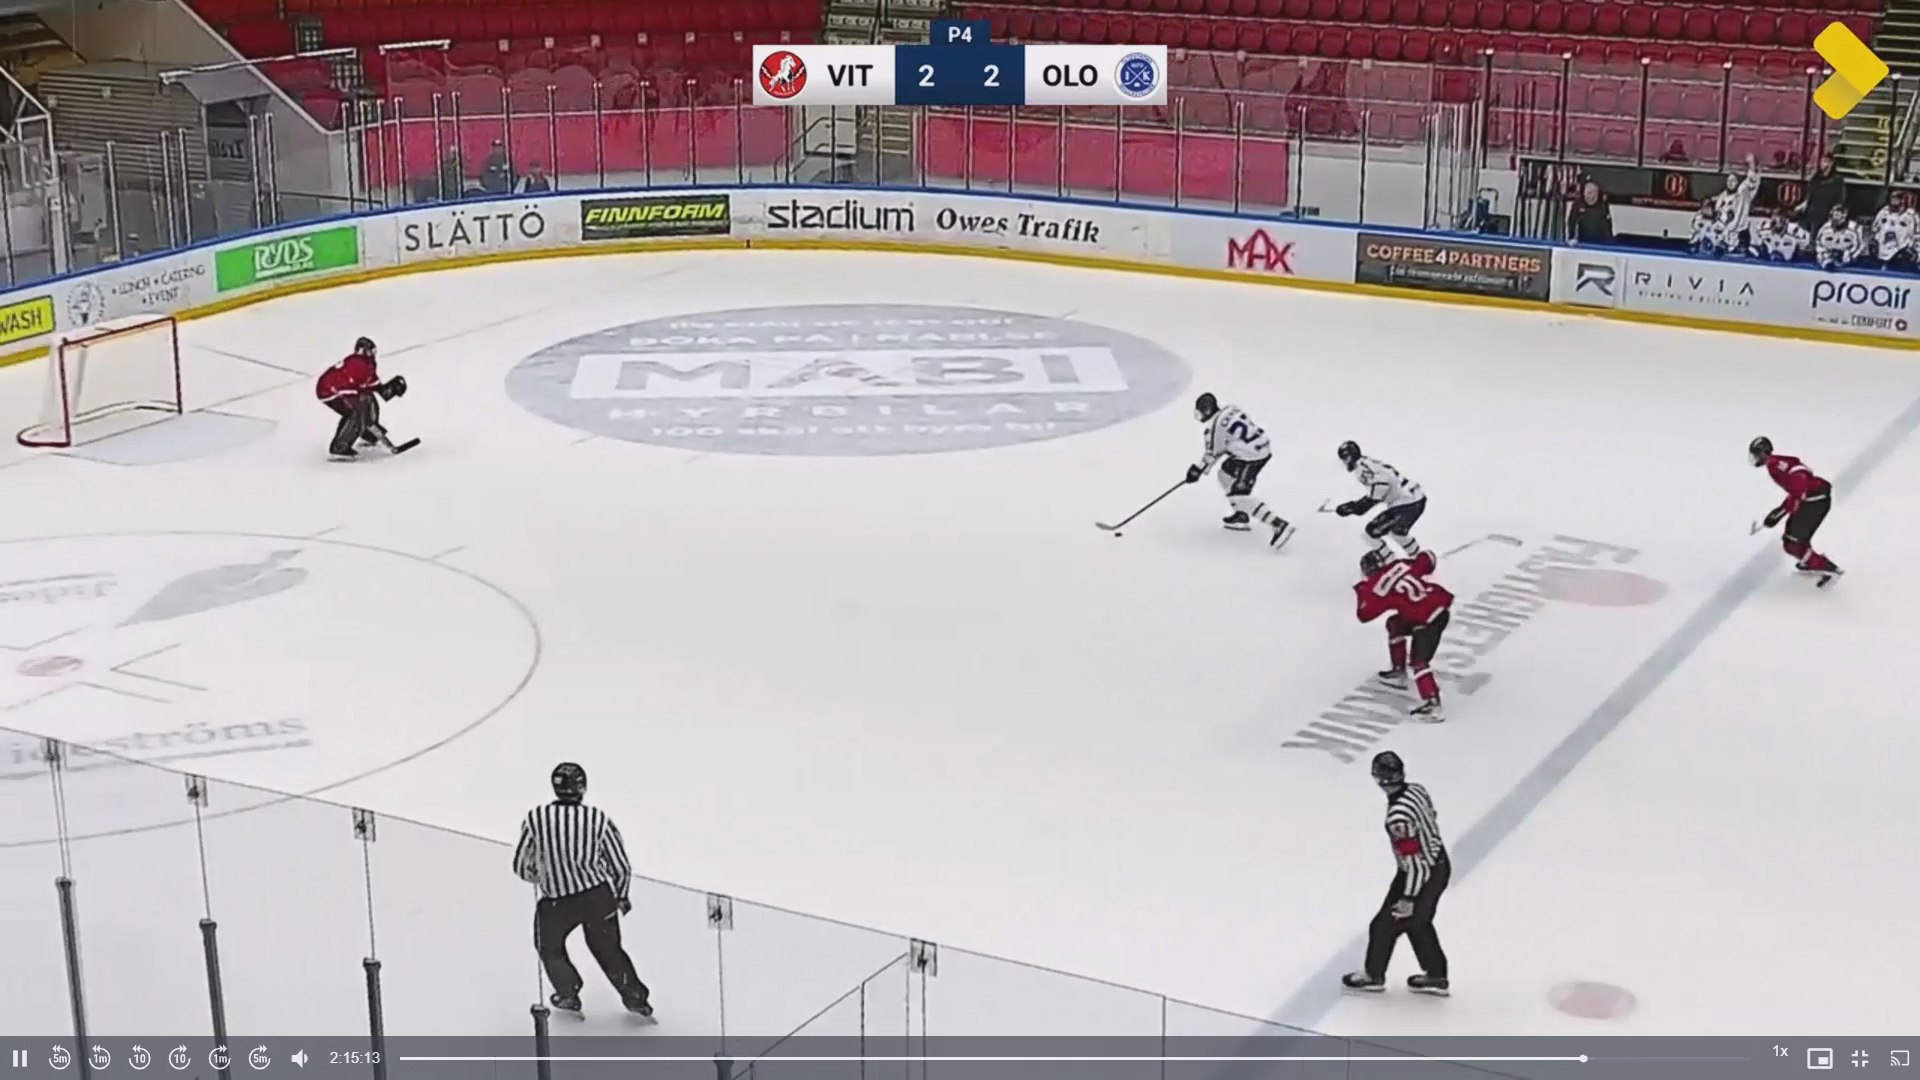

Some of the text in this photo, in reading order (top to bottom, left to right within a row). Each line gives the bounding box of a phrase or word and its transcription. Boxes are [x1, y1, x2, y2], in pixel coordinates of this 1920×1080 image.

[405, 204, 545, 251] SLÄTTÖ
[767, 200, 914, 232] stadium
[936, 207, 1100, 244] Owes Trafik
[1227, 228, 1295, 275] MAX
[1366, 243, 1541, 273] COFFEE4PARTNERS
[1812, 280, 1911, 310] proair
[615, 354, 1083, 391] MABI
